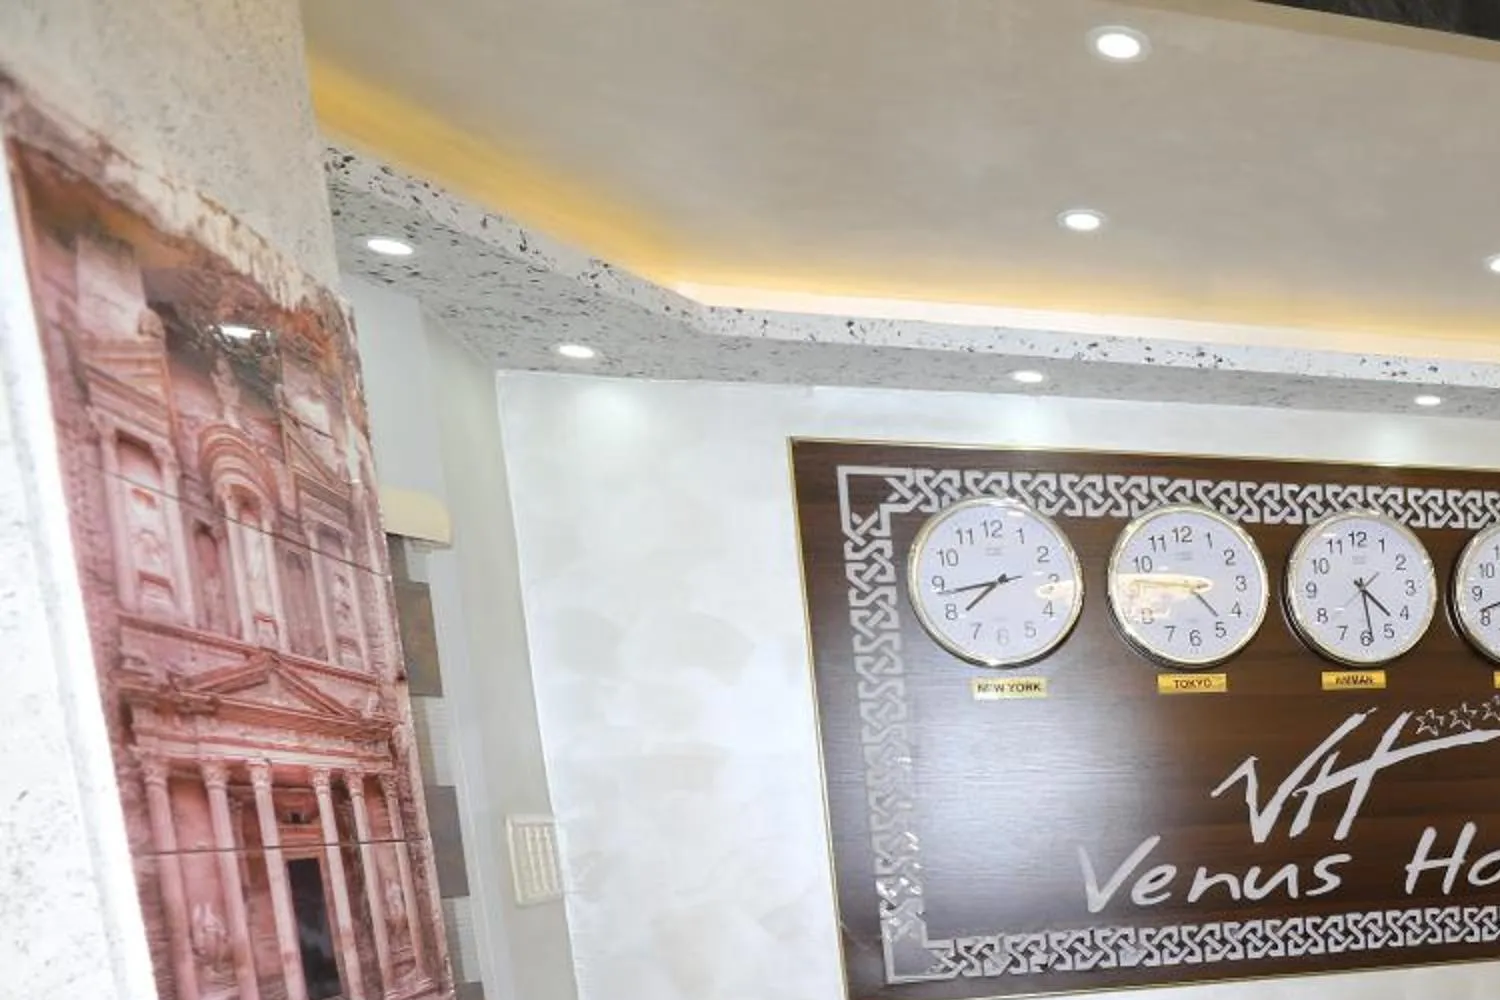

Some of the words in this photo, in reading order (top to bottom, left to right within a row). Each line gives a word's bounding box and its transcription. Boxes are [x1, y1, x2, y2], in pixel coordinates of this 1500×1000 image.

[956, 528, 974, 545] 11
[981, 520, 1003, 538] 12
[1016, 528, 1025, 544] 1
[1172, 526, 1192, 543] 12
[1149, 535, 1166, 552] 11
[1206, 532, 1213, 548] 1
[1326, 539, 1343, 554] 11
[1348, 531, 1367, 547] 12
[1379, 538, 1385, 553] 1
[937, 549, 959, 567] 10
[1037, 546, 1050, 563] 2
[1224, 549, 1236, 566] 2
[1395, 554, 1407, 570] 2
[1134, 555, 1153, 573] 10
[1312, 558, 1329, 574] 10
[1479, 562, 1495, 578] 10
[931, 576, 945, 592] 9
[1235, 576, 1247, 592] 3
[1305, 583, 1317, 599] 9
[1406, 580, 1416, 596] 3
[1472, 586, 1482, 601] 9
[945, 604, 958, 620] 8
[1042, 603, 1054, 617] 4
[1231, 601, 1242, 618] 4
[1317, 608, 1328, 623] 8
[1400, 606, 1409, 621] 4
[1480, 611, 1491, 626] 8
[971, 623, 982, 640] 7
[997, 629, 1009, 645] 6
[1024, 622, 1037, 638] 5
[1164, 626, 1177, 642] 7
[1190, 630, 1202, 646] 6
[1215, 622, 1227, 638] 5
[1338, 626, 1348, 640] 7
[1384, 624, 1395, 639] 5
[1360, 631, 1374, 646] 6
[1008, 681, 1042, 692] YORK
[1174, 678, 1213, 689] TOKYO
[1077, 835, 1352, 913] Venus
